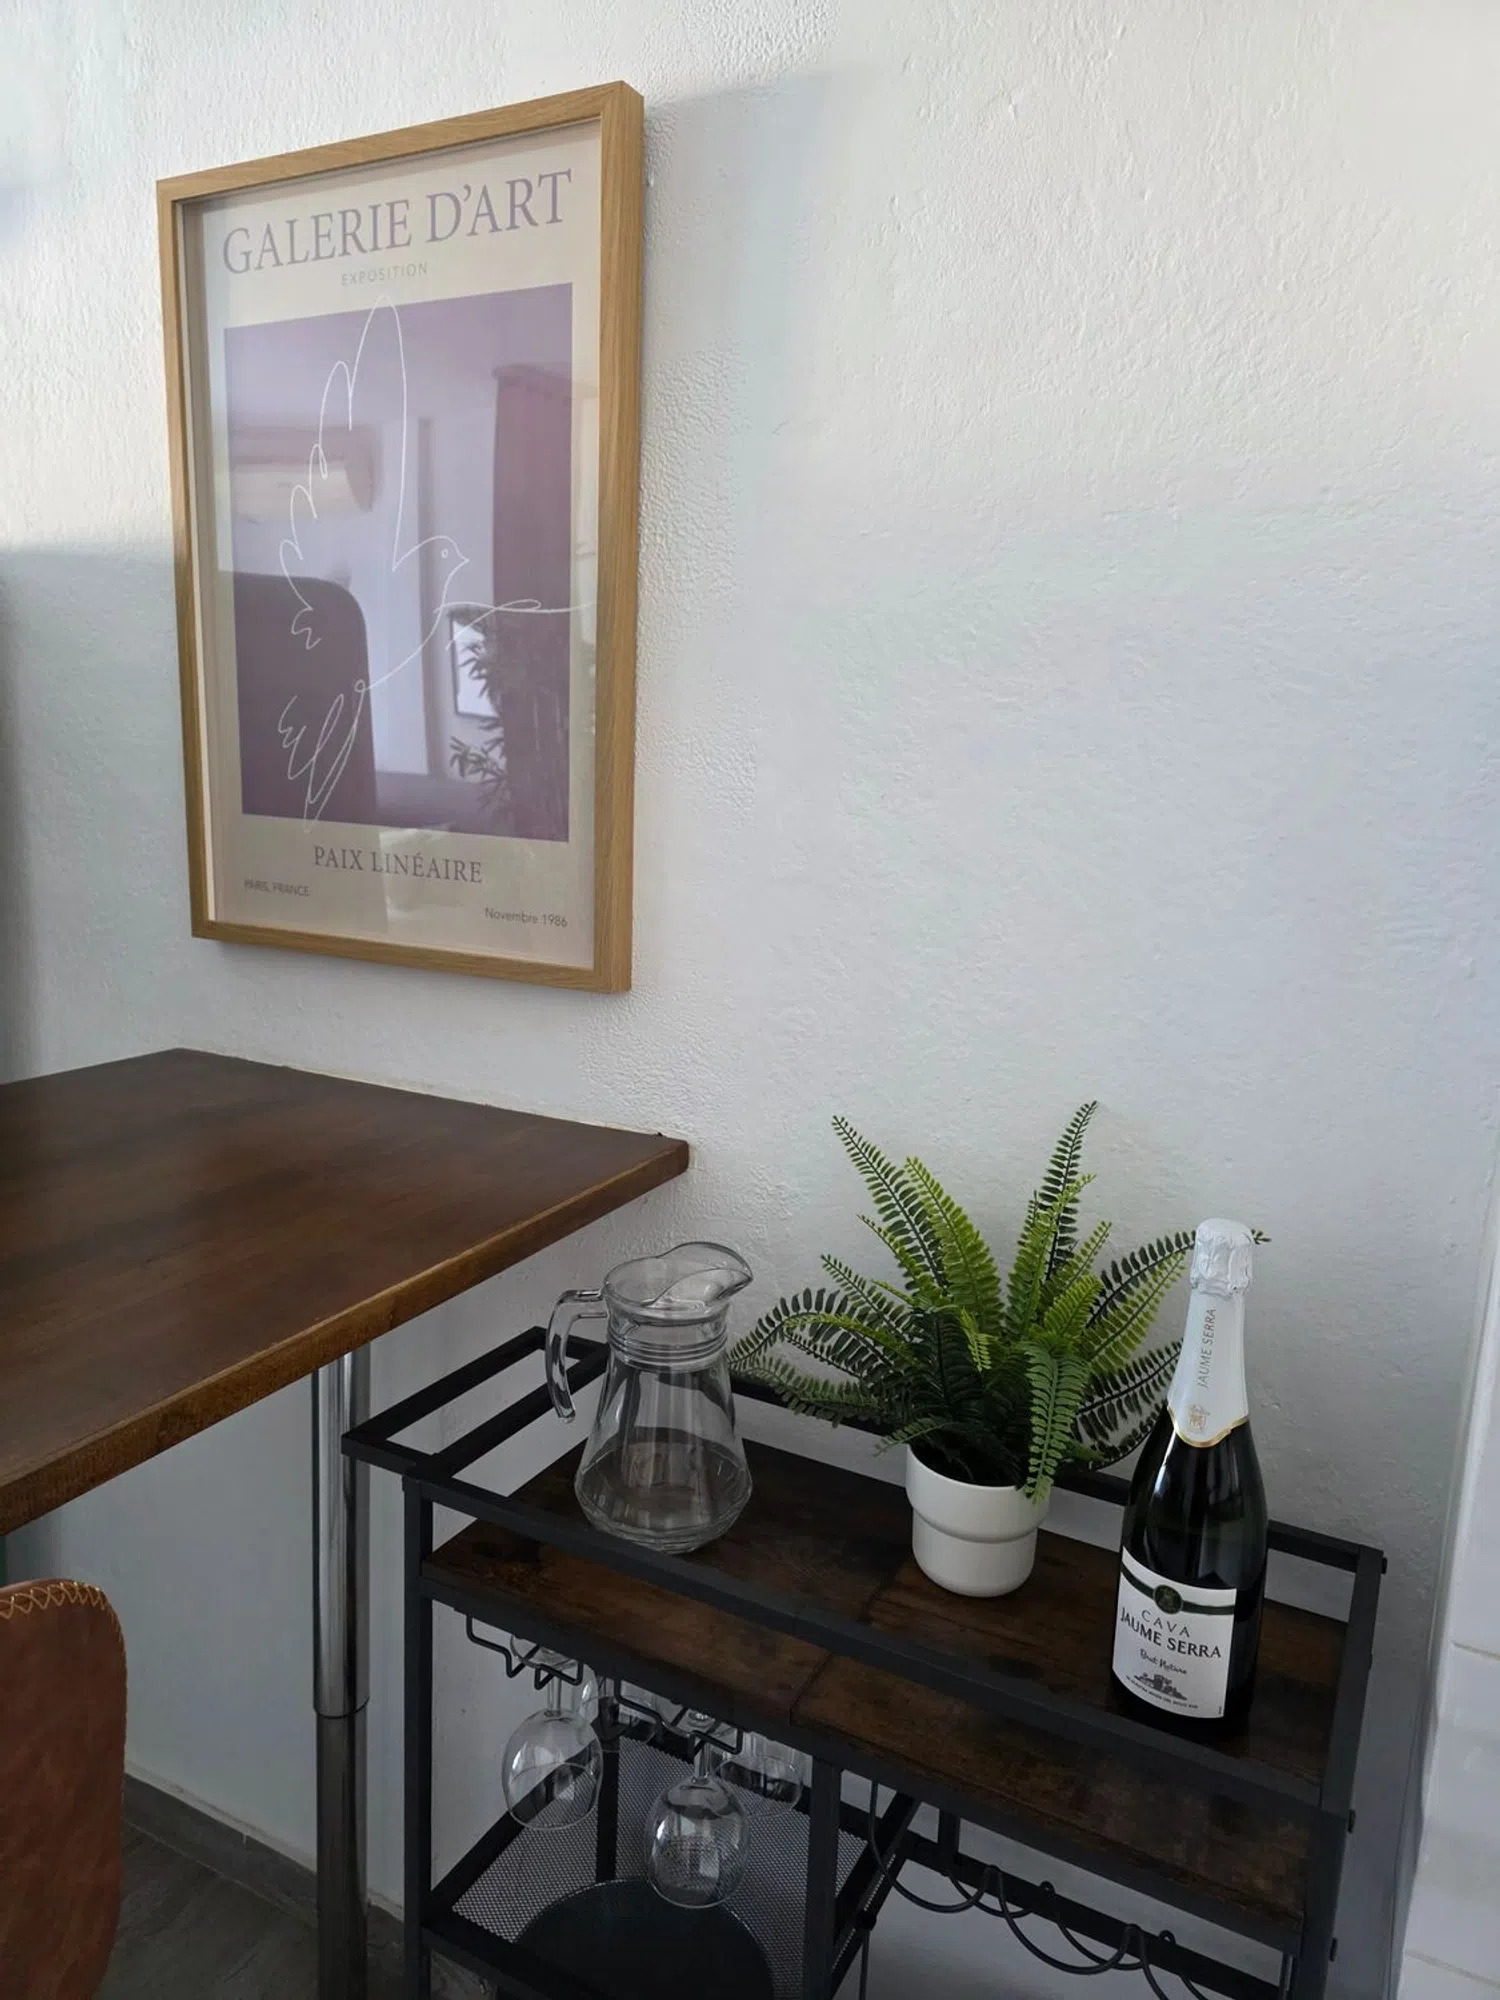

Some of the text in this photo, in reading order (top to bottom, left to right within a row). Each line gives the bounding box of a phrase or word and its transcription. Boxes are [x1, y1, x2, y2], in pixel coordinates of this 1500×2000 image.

[223, 168, 573, 275] GALERIE D'ART
[341, 262, 428, 286] EXPOSITION
[313, 845, 483, 884] PAIX LINÉAIRE
[272, 881, 310, 897] FRANCE
[485, 907, 568, 928] Novembre 1986
[1198, 1308, 1216, 1389] JAUME SERRA
[1120, 1607, 1222, 1659] JAUME SERRA
[1141, 1609, 1190, 1638] CAVA
